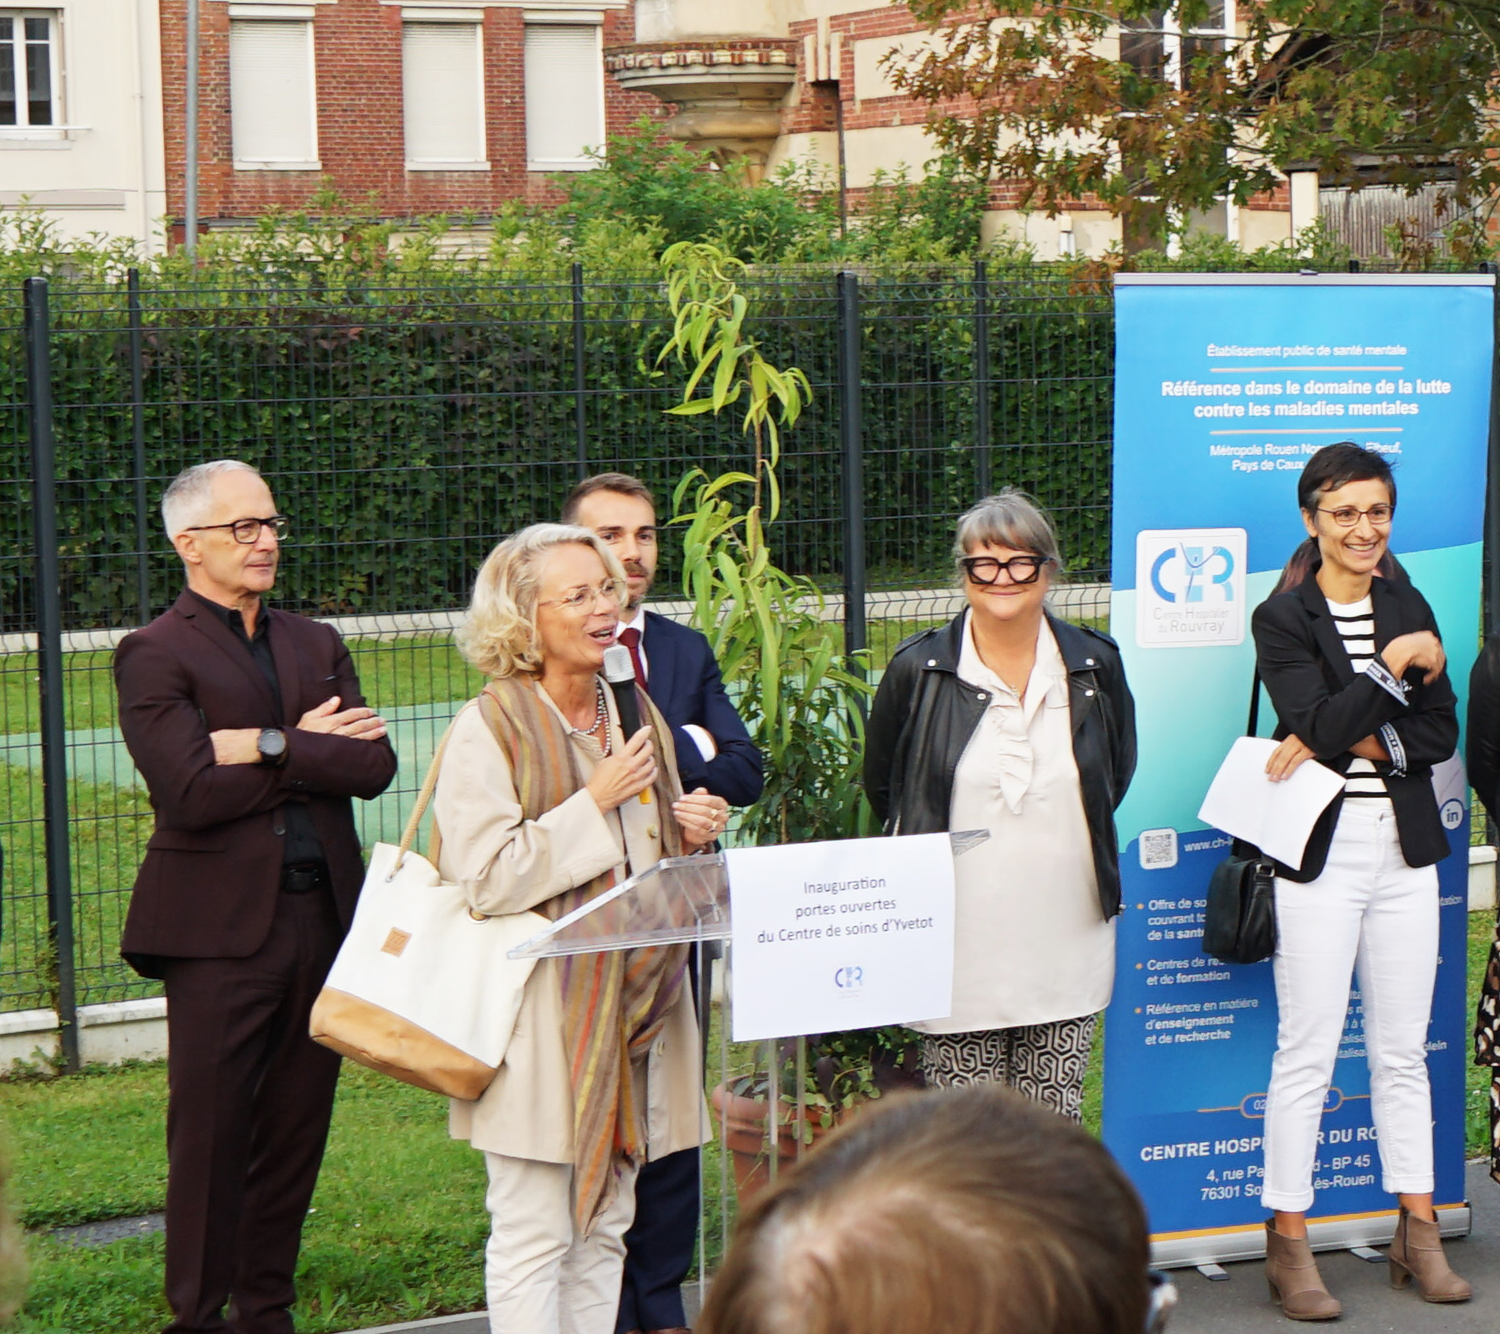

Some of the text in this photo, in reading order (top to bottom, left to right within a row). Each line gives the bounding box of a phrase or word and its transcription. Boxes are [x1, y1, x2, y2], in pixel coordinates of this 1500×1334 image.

[1206, 343, 1407, 358] Établissement public de santé mentale
[1161, 378, 1452, 397] Référence dans le domaine de la lutte
[1193, 400, 1420, 418] contre les maladies mentales
[1209, 443, 1263, 458] Métropole
[1264, 443, 1299, 455] Rouen
[1231, 459, 1259, 473] Pays
[1260, 459, 1275, 471] de
[1170, 620, 1225, 634] Rouvray
[1446, 808, 1460, 823] in
[803, 876, 887, 895] Inauguration
[795, 898, 896, 920] portes ouvertes
[1148, 898, 1176, 911] Offre
[1177, 897, 1192, 909] de
[1147, 913, 1195, 926] couvrant
[757, 915, 934, 944] du Centre de soins d'Yvetot
[1147, 929, 1162, 941] de
[1164, 928, 1175, 940] la
[1146, 958, 1189, 971] Centres
[1191, 957, 1206, 968] de
[1146, 970, 1231, 986] et de formation
[1146, 997, 1259, 1015] Référence en matière
[1145, 1014, 1235, 1030] d'enseignement
[1145, 1029, 1231, 1046] et de recherche
[1140, 1142, 1210, 1162] CENTRE
[1329, 1129, 1353, 1144] DU
[1206, 1170, 1219, 1184] 4,
[1222, 1167, 1244, 1181] rue
[1332, 1156, 1352, 1170] BP
[1354, 1154, 1371, 1168] 45
[1200, 1187, 1240, 1201] 76301
